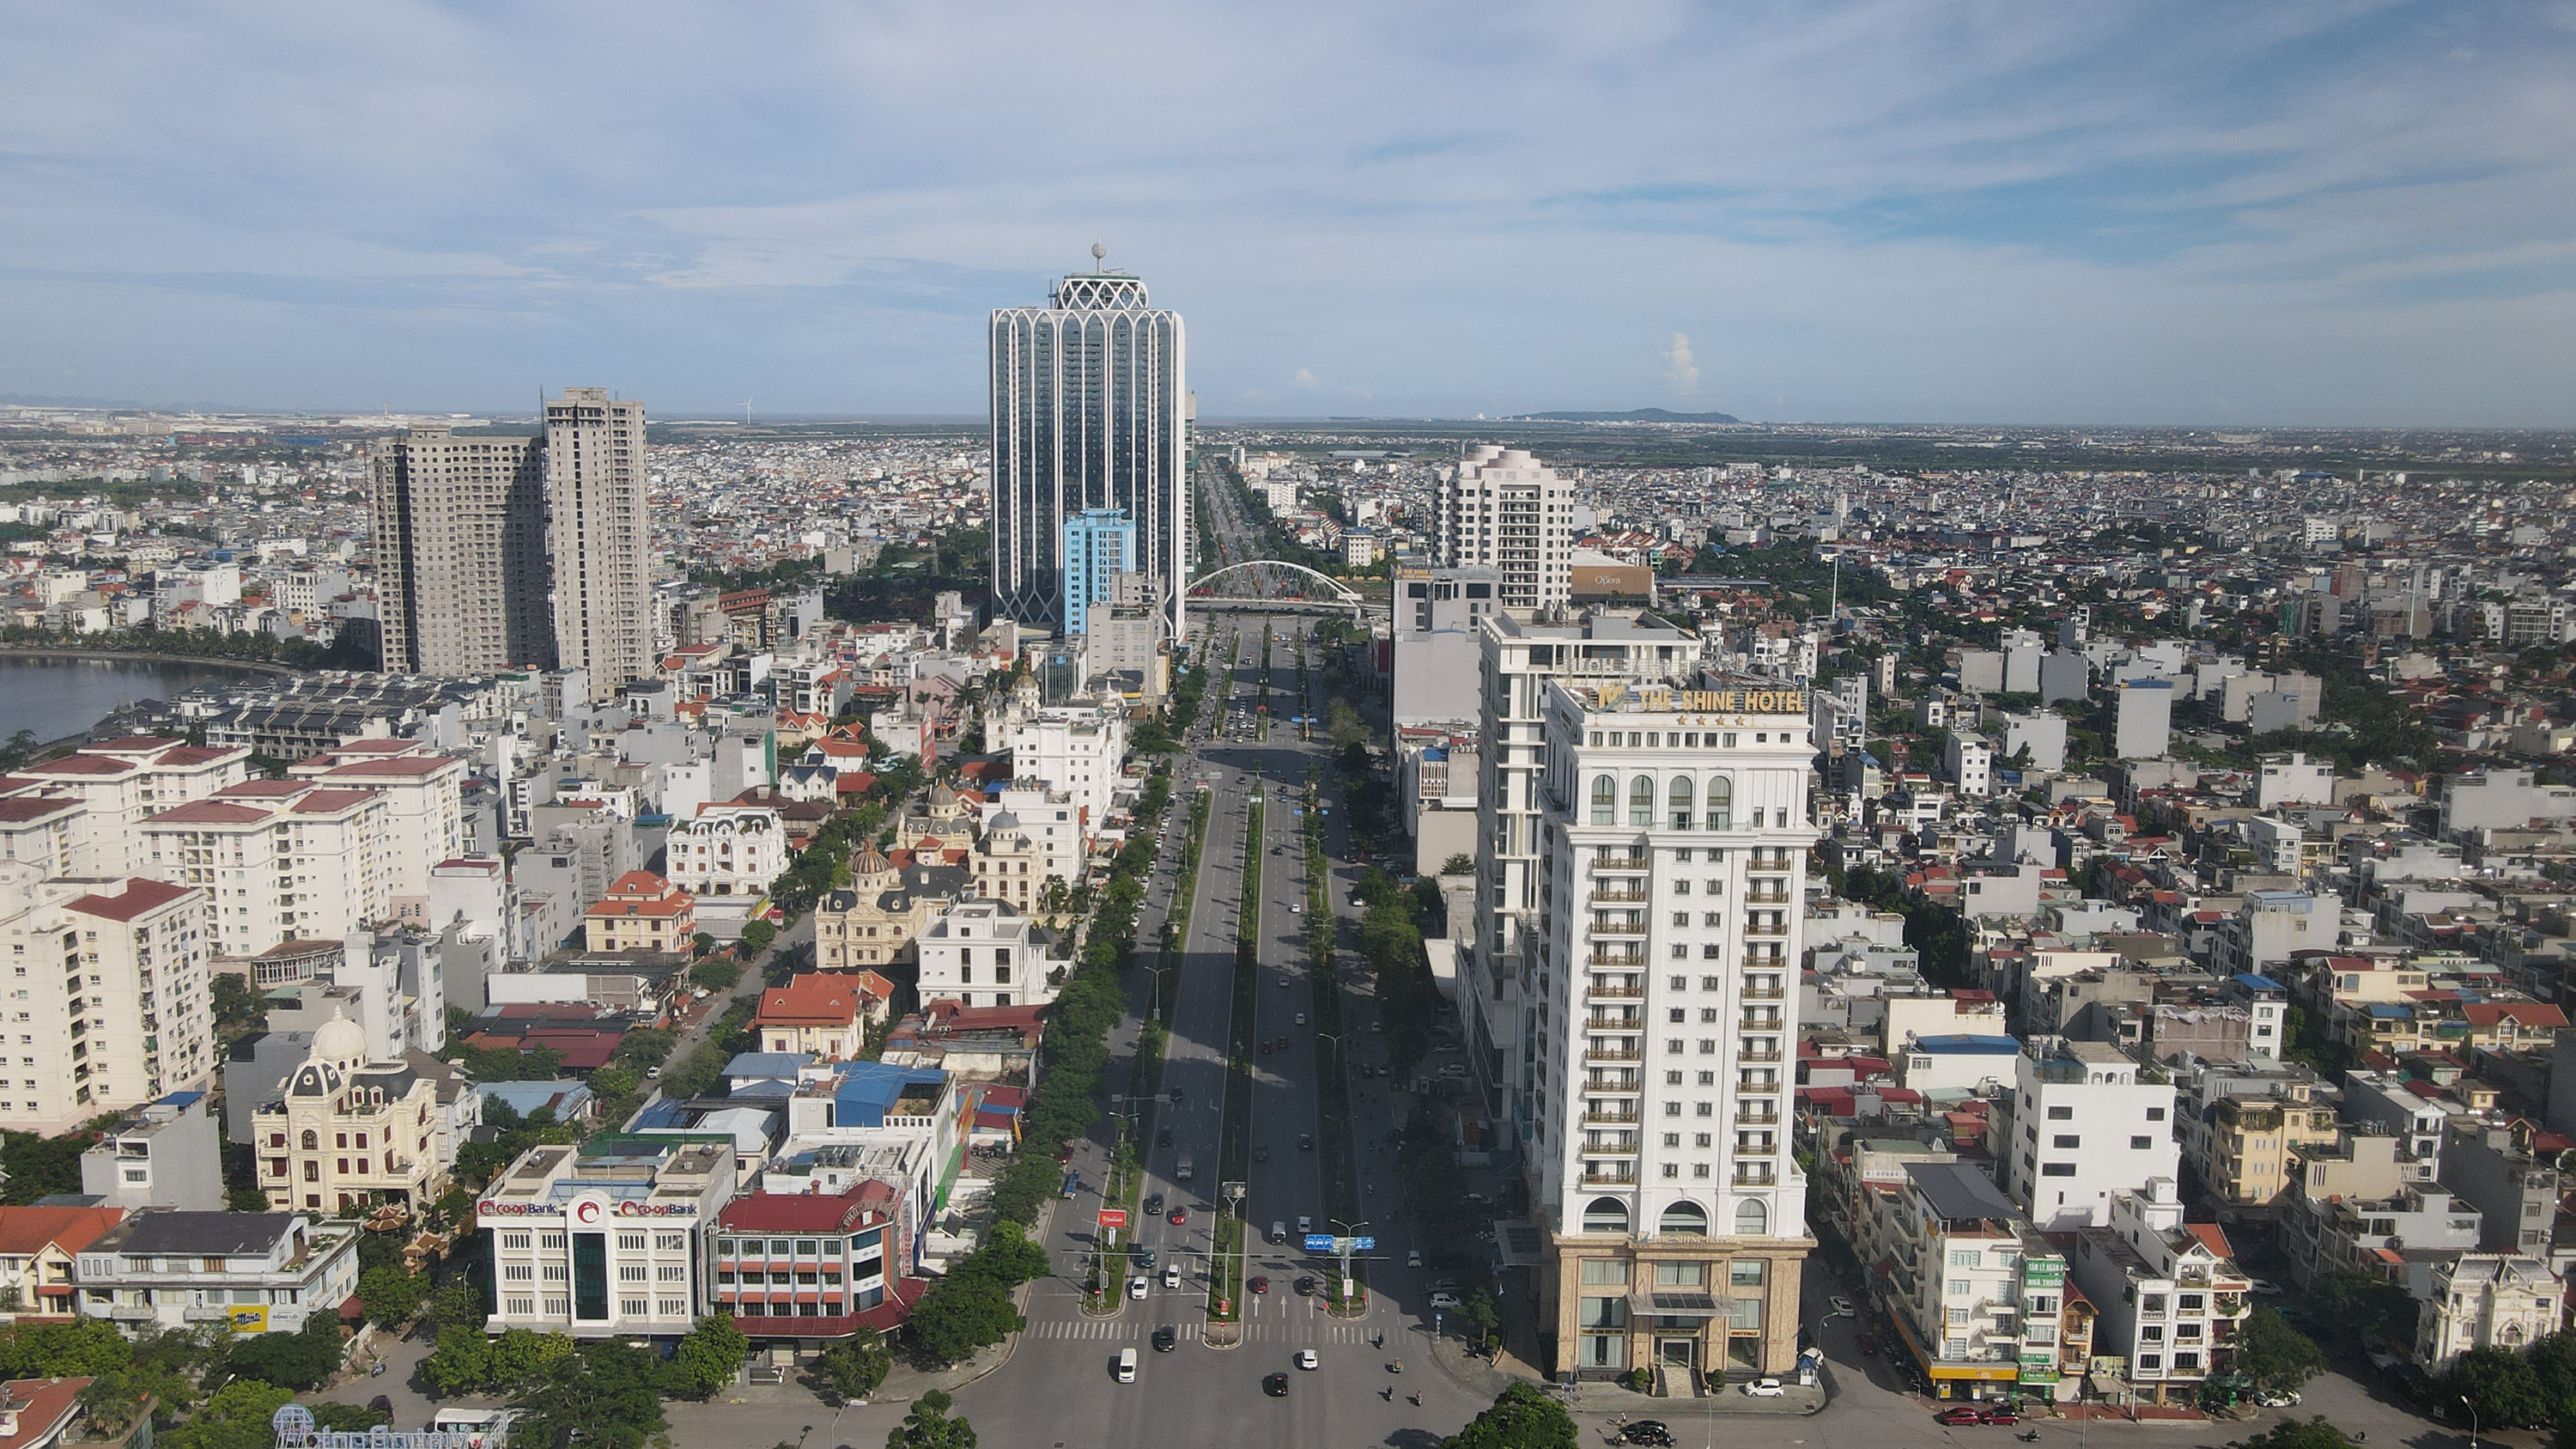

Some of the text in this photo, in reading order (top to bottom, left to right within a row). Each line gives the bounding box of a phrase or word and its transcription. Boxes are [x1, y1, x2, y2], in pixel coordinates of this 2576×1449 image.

[1595, 575, 1621, 588] Opera
[1638, 690, 1807, 712] THE SHINE HOTEL
